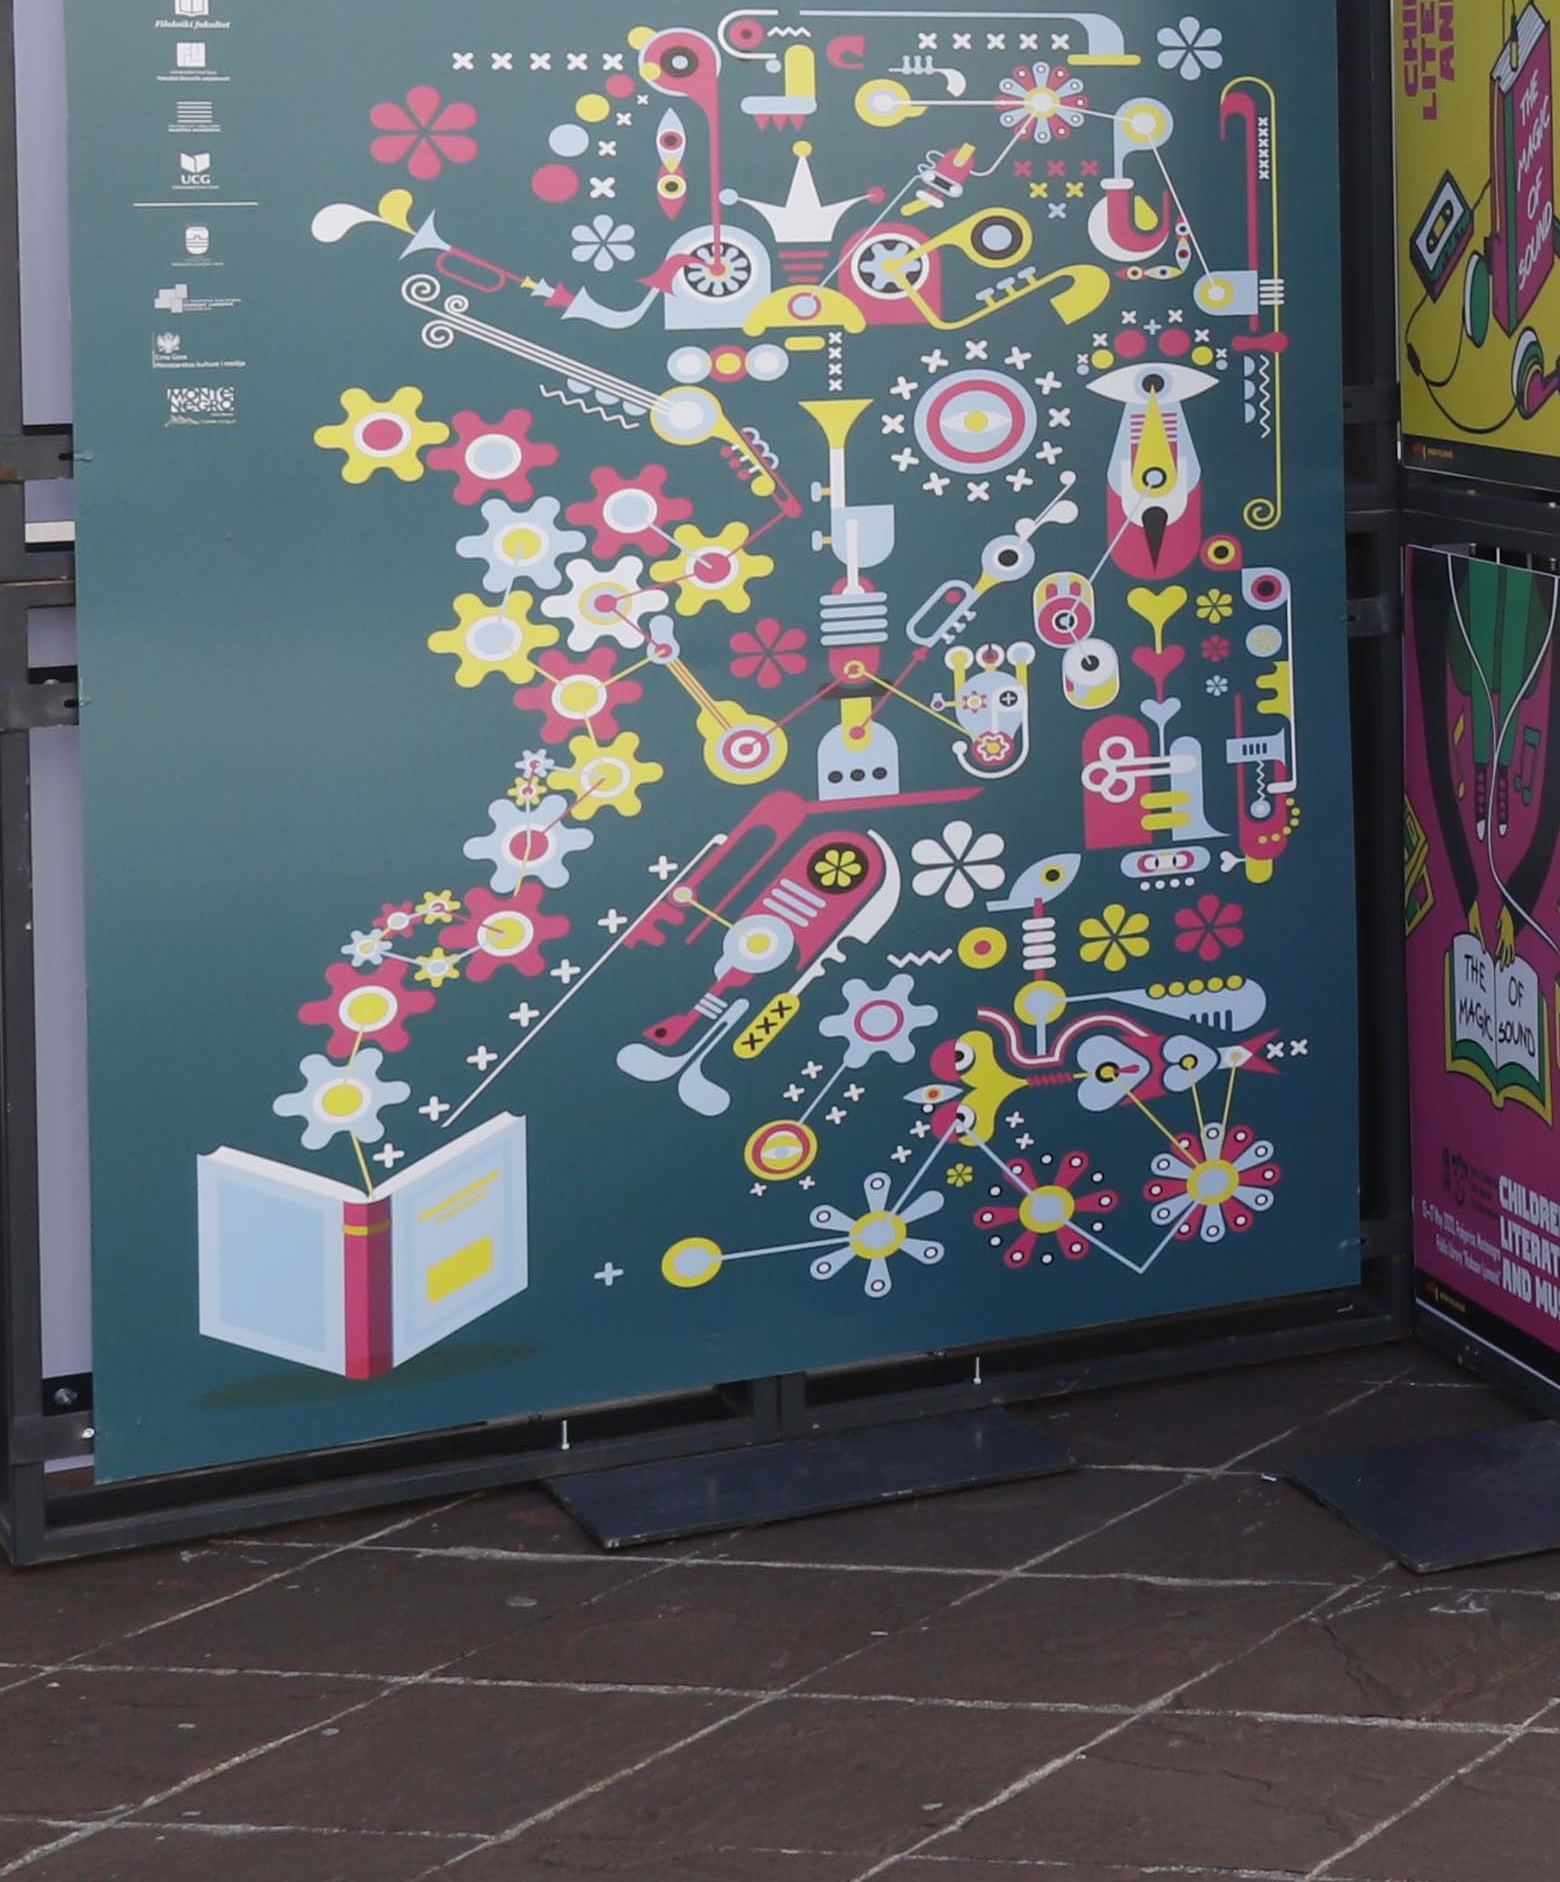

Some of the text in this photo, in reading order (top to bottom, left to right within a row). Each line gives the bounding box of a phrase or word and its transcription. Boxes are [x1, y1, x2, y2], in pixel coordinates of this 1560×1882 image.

[1519, 69, 1539, 127] THE
[1517, 94, 1551, 192] MAGIC
[181, 174, 210, 185] UCG
[1527, 166, 1543, 220] OF
[1518, 200, 1553, 291] SOUND
[1464, 954, 1488, 994] THE
[1508, 975, 1525, 1009] OF
[1459, 997, 1494, 1042] MAGIC
[1498, 1021, 1536, 1058] SOUND
[1502, 1257, 1533, 1303] AND
